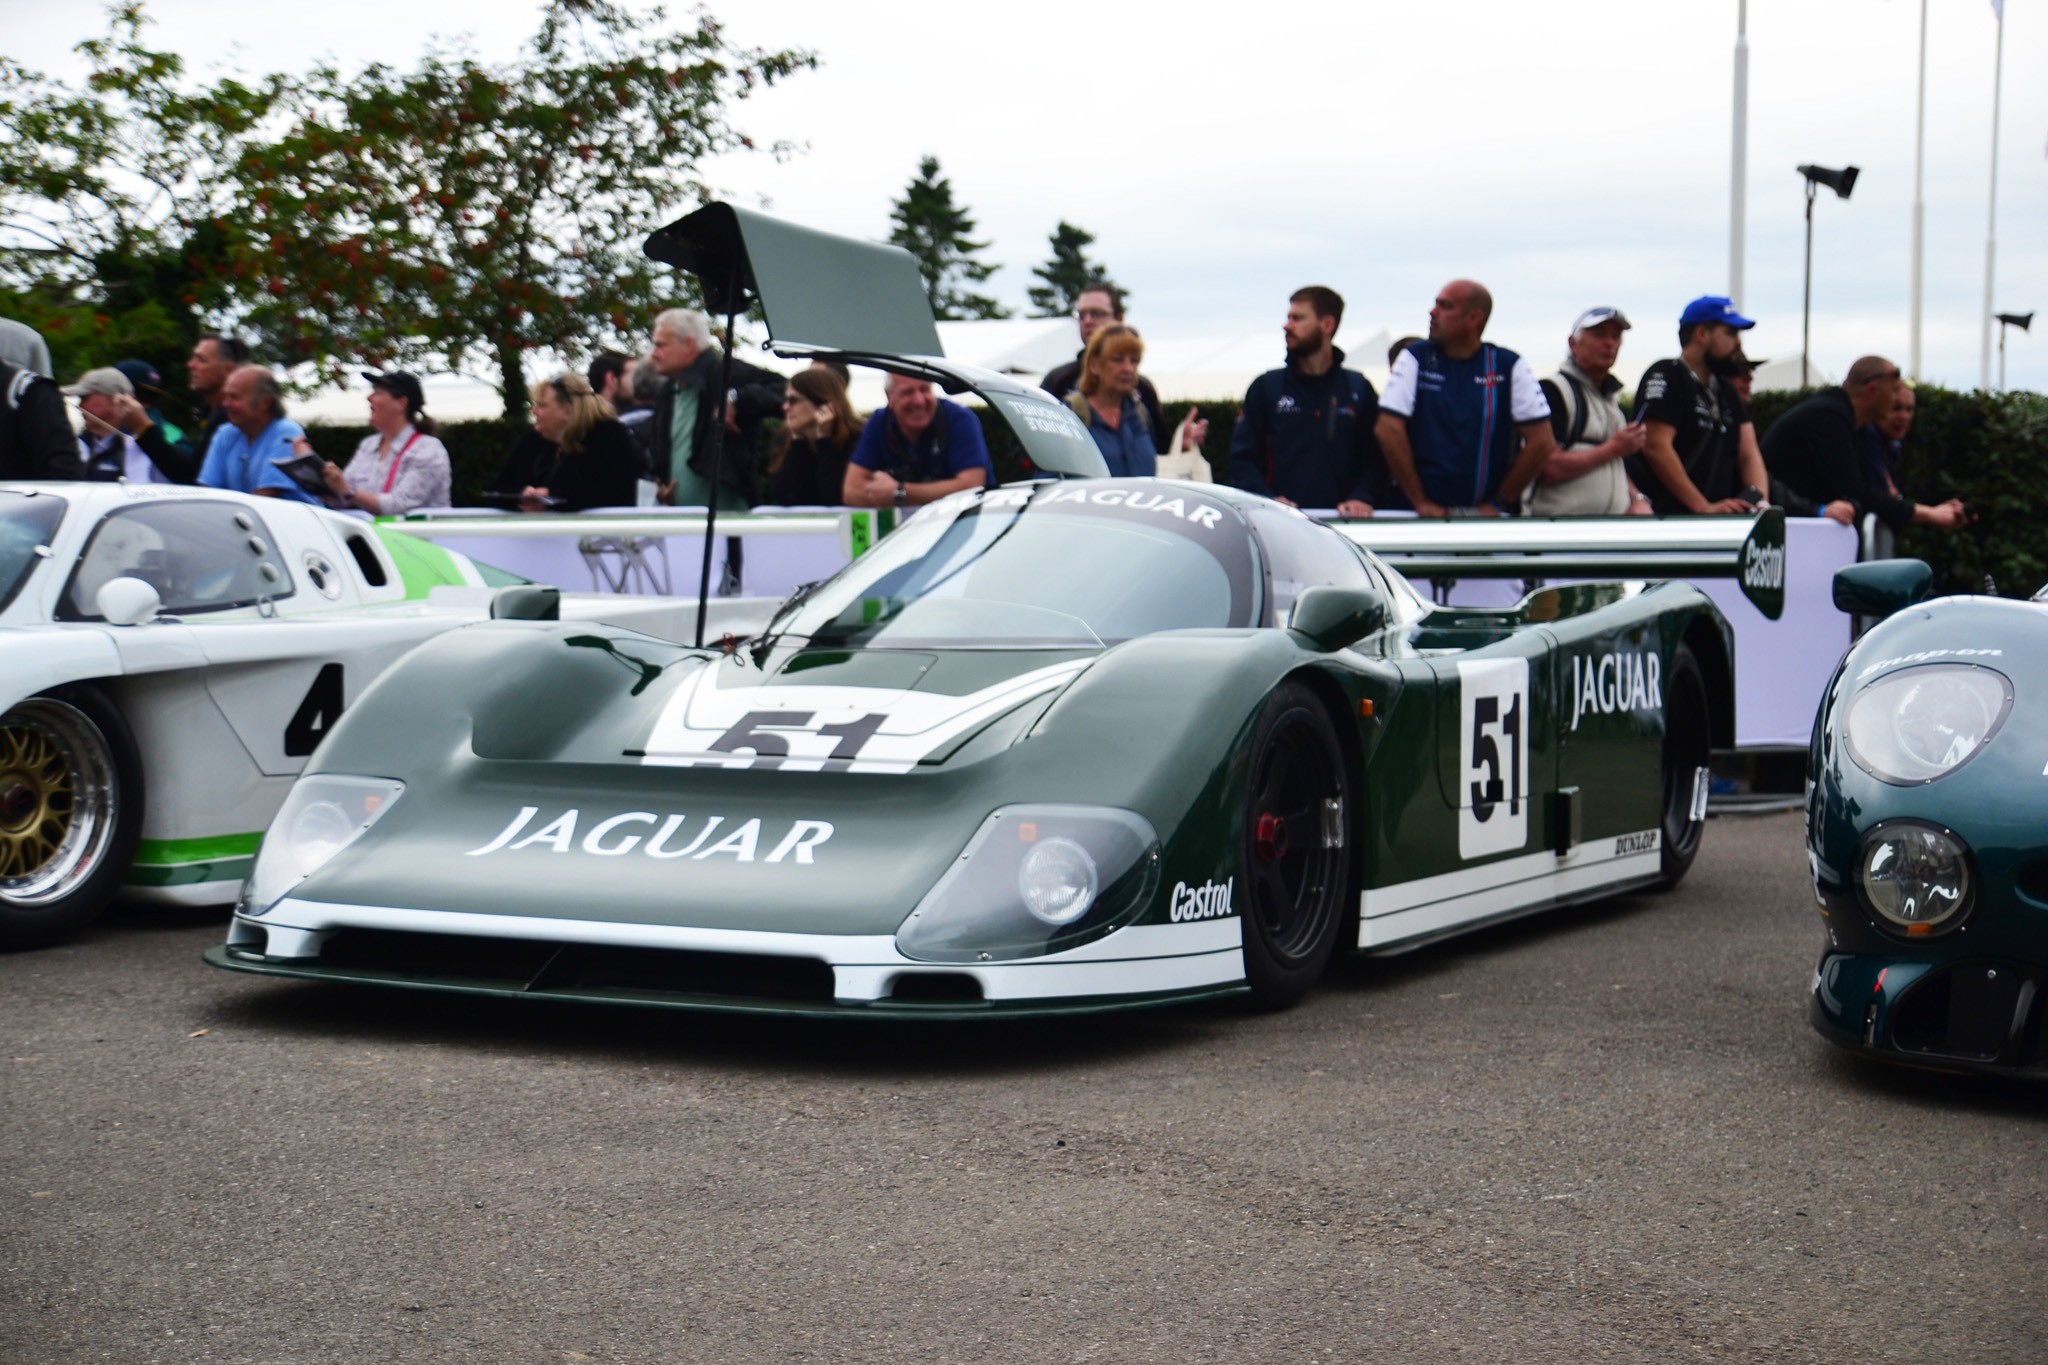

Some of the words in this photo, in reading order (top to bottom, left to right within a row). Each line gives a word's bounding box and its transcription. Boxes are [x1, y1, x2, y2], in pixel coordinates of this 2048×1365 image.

[1033, 488, 1223, 529] JAGUAR
[1571, 652, 1662, 731] JAGUAR
[692, 710, 890, 771] 51
[1471, 693, 1520, 822] 51
[464, 806, 835, 864] JAGUAR
[1615, 832, 1657, 855] DUNLOP
[1171, 876, 1234, 922] Castrol
